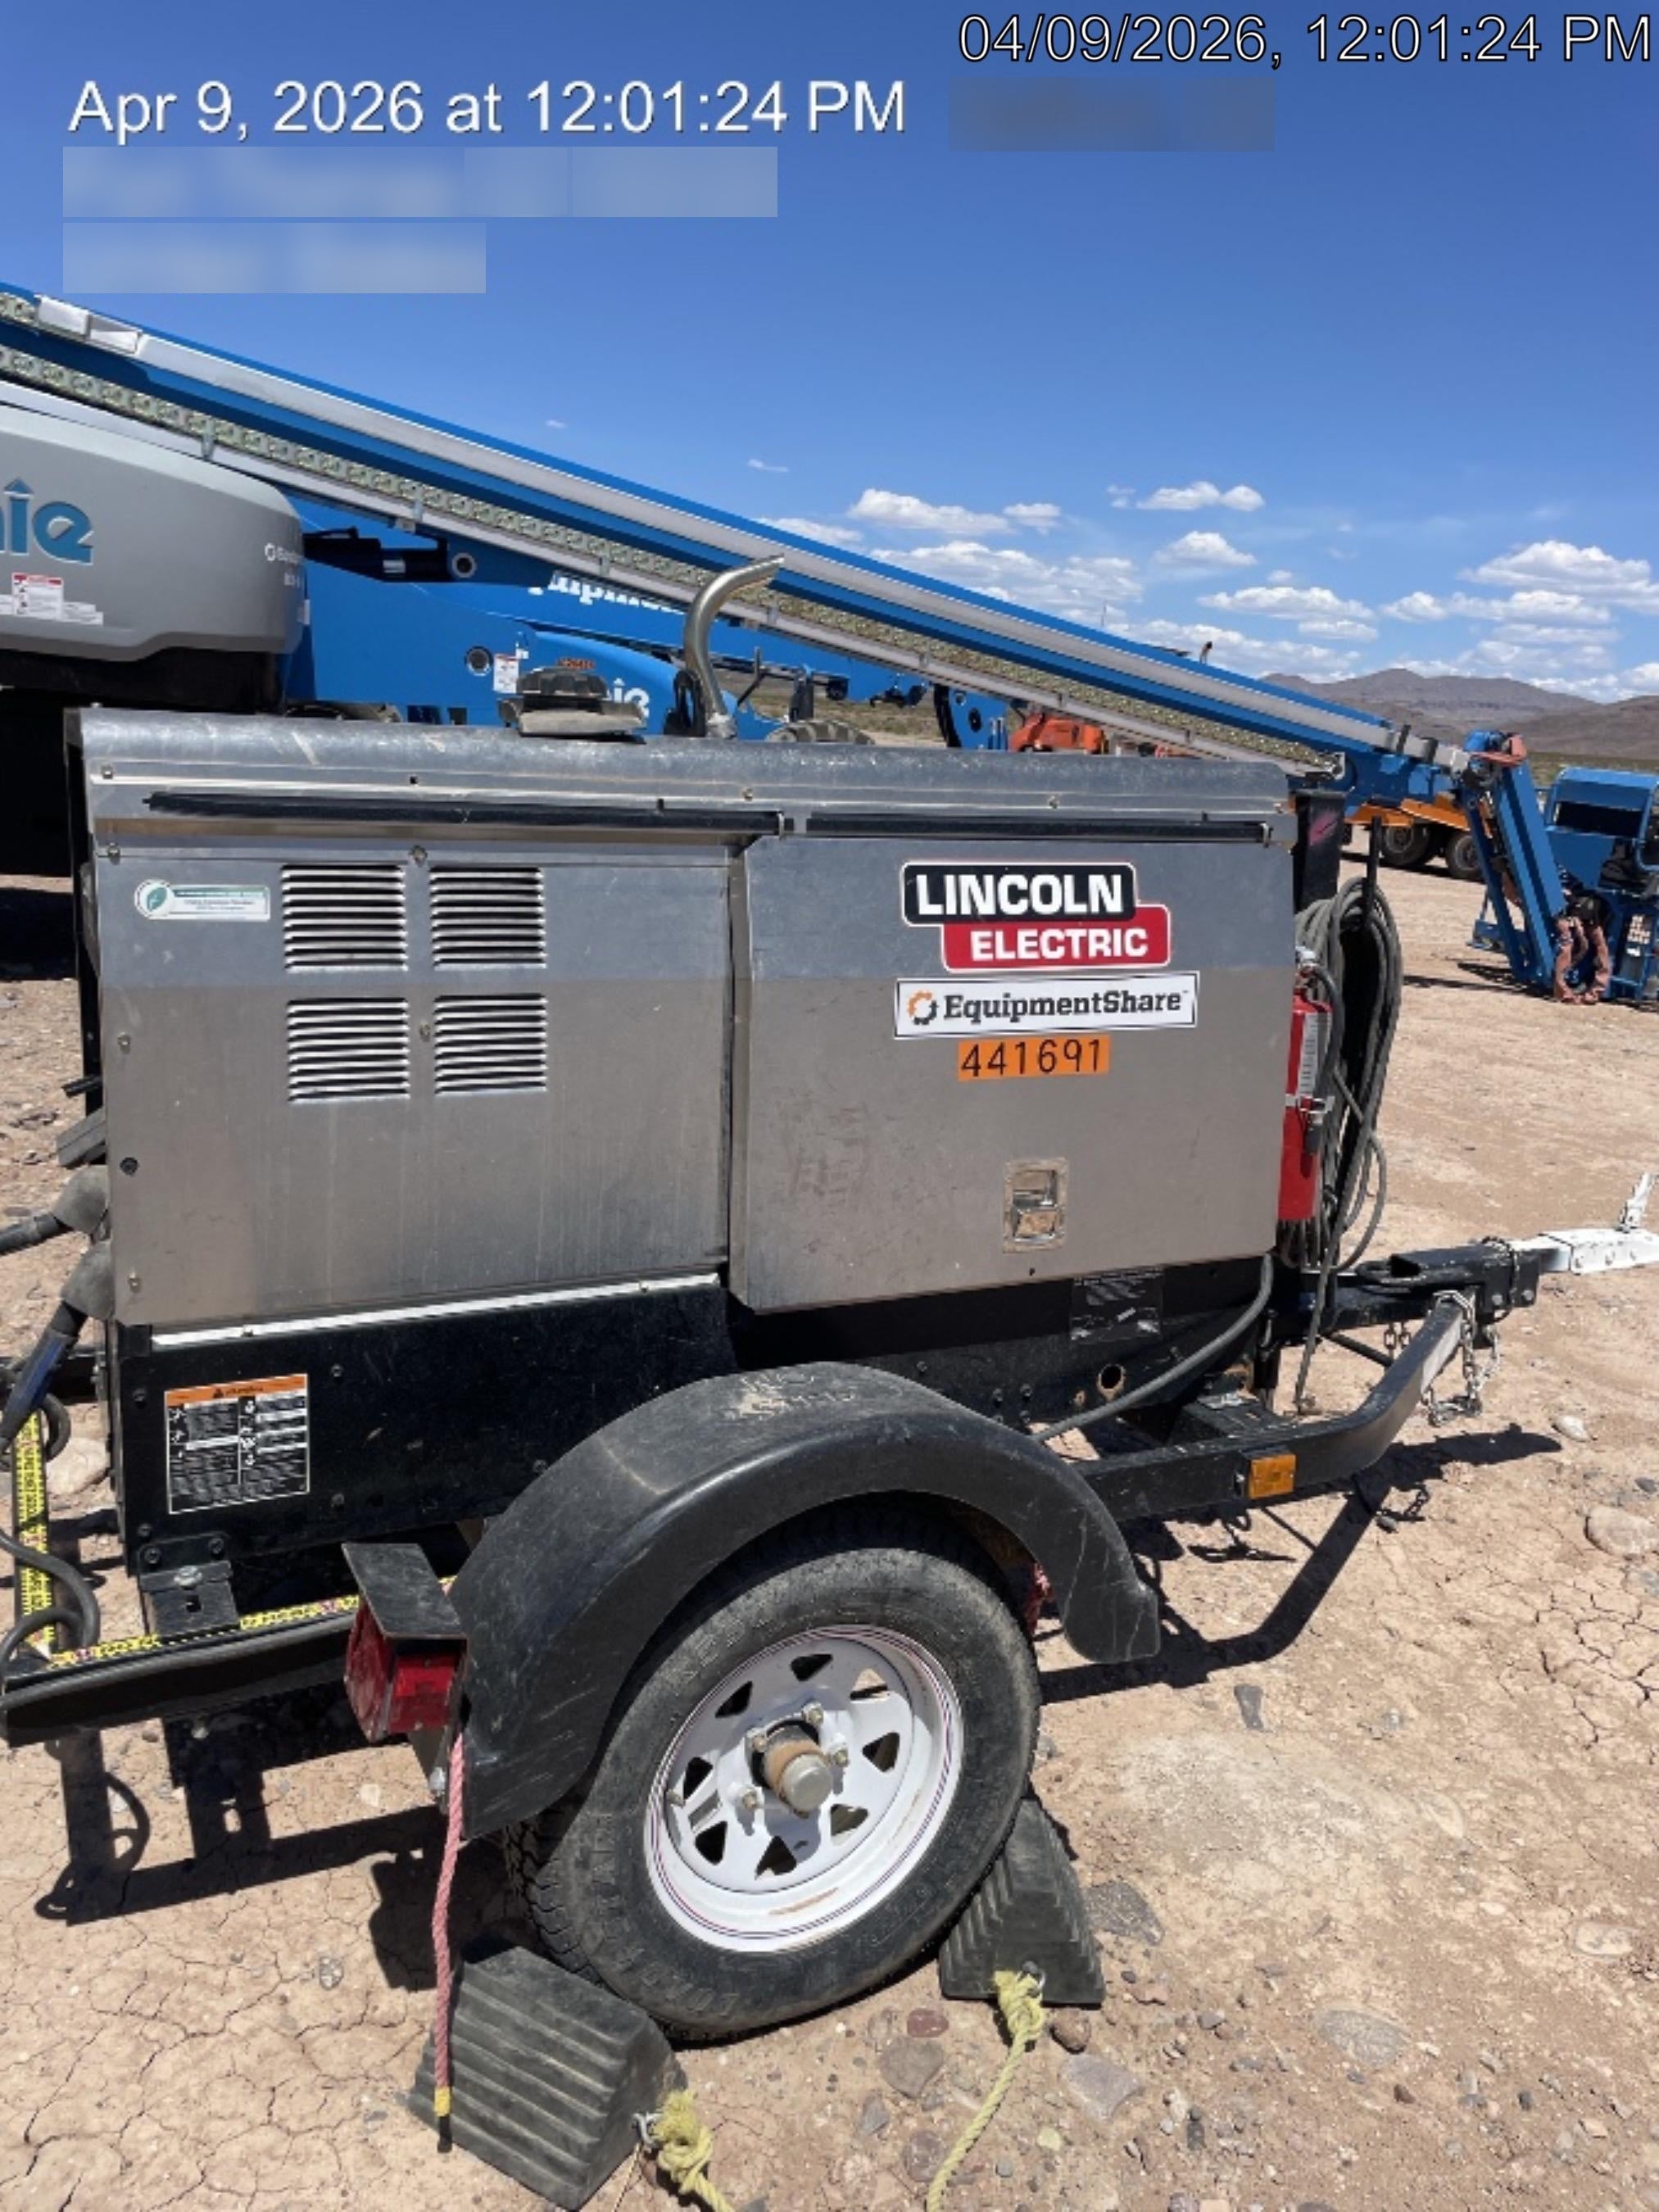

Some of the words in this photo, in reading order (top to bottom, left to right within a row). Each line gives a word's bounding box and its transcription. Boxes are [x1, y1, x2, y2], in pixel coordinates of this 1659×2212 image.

[916, 874, 1122, 916] LINCOLN
[970, 927, 1149, 962] ELECTRIC
[943, 989, 1181, 1024] EquipmentShare
[961, 1038, 1101, 1077] 441691
